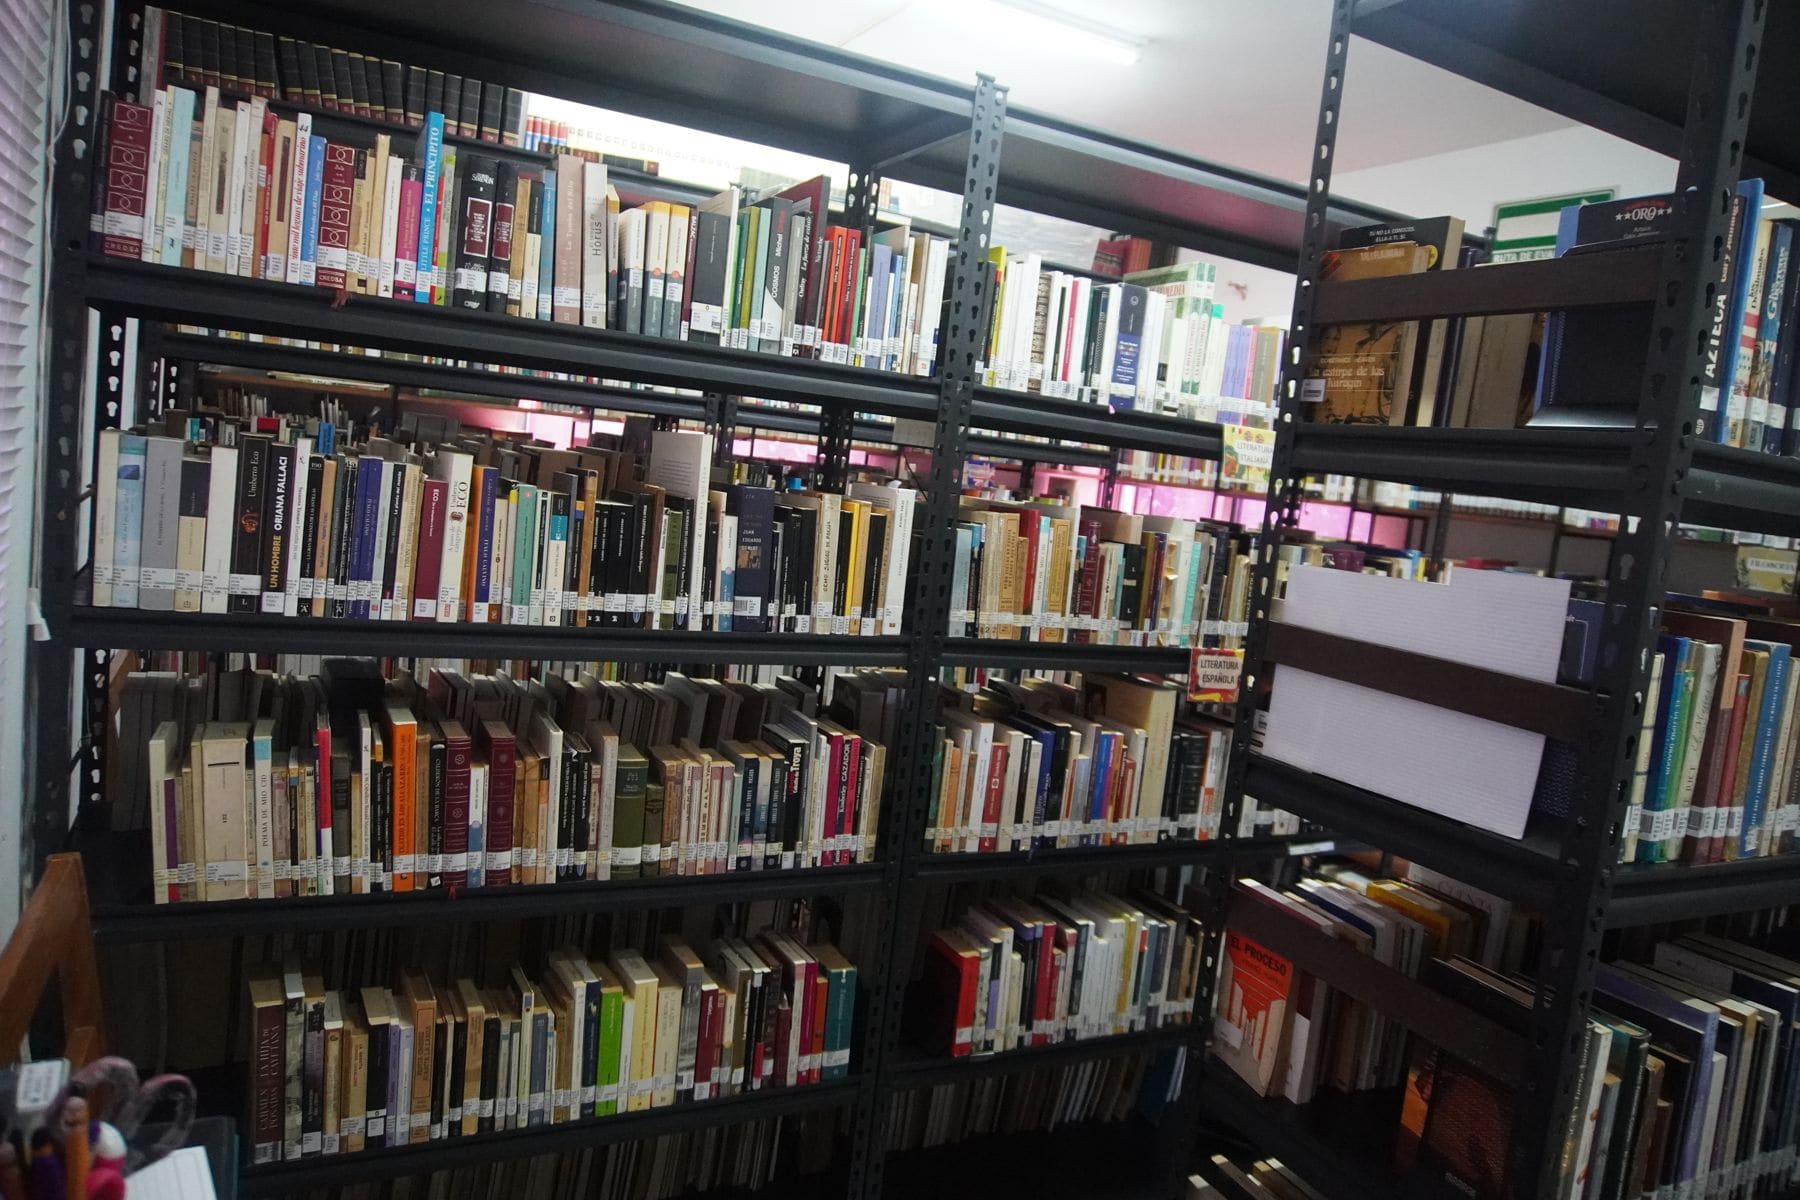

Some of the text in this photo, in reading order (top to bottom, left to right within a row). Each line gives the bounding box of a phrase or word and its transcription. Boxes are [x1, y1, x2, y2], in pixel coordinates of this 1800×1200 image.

[295, 137, 306, 176] submarino
[424, 127, 440, 204] EL PRINCIPITO
[293, 196, 302, 204] de
[294, 177, 304, 196] viaje
[1631, 206, 1657, 221] ORO
[290, 232, 299, 244] mil
[420, 216, 432, 271] LITTLE PRINCE
[591, 221, 603, 257] Horus
[774, 233, 784, 257] Michel
[800, 261, 808, 271] La
[804, 235, 811, 243] de
[1494, 252, 1518, 263] RUTA
[1519, 251, 1533, 261] DE
[318, 273, 345, 287] CREDSA
[771, 265, 781, 298] COSMOS
[1704, 293, 1727, 379] AZTECA
[1719, 254, 1732, 283] Gary
[1356, 366, 1366, 376] de
[1371, 366, 1385, 376] los
[248, 450, 260, 498] Umberto Eco
[273, 456, 288, 531] ORIANA FALLACI
[432, 488, 440, 501] ECO
[456, 481, 469, 509] ECO
[270, 535, 282, 588] UN HOMBRE
[480, 557, 488, 586] CALVINO
[1200, 659, 1239, 670] LITERATURA
[1202, 672, 1235, 685] ESPAÑOLA
[790, 746, 802, 772] Troya
[841, 743, 851, 782] CAZADOR
[434, 787, 441, 795] DE
[260, 774, 269, 847] POEMA DE MIO CID
[433, 803, 441, 822] BARCA
[1231, 936, 1286, 976] EL PROCESO
[259, 1039, 270, 1061] HIJA
[270, 1024, 281, 1076] CAYETANA
[259, 1064, 269, 1078] LA
[258, 1086, 280, 1131] CARMEN POSADAS
